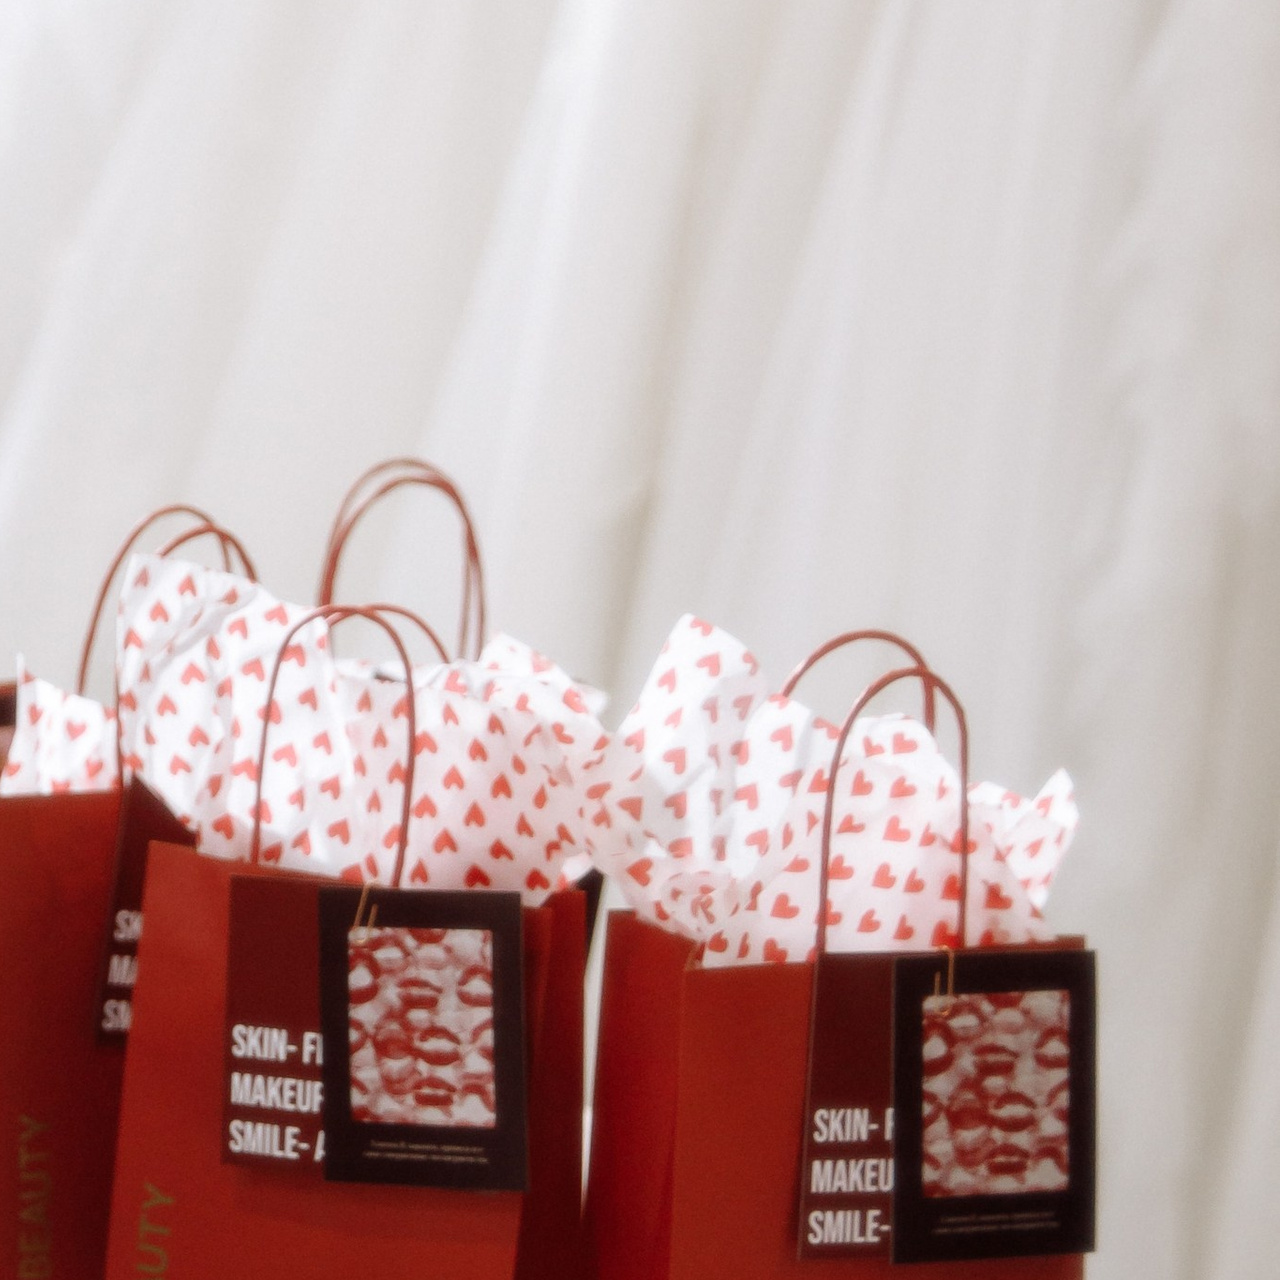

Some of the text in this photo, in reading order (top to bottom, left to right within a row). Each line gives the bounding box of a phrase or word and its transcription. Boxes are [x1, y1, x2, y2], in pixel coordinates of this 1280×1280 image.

[231, 1024, 298, 1063] SKIN-
[228, 1119, 310, 1160] SMILE-
[813, 1107, 880, 1144] SKIN-
[18, 1113, 54, 1280] BEAUTY
[807, 1209, 892, 1245] SMILE-
